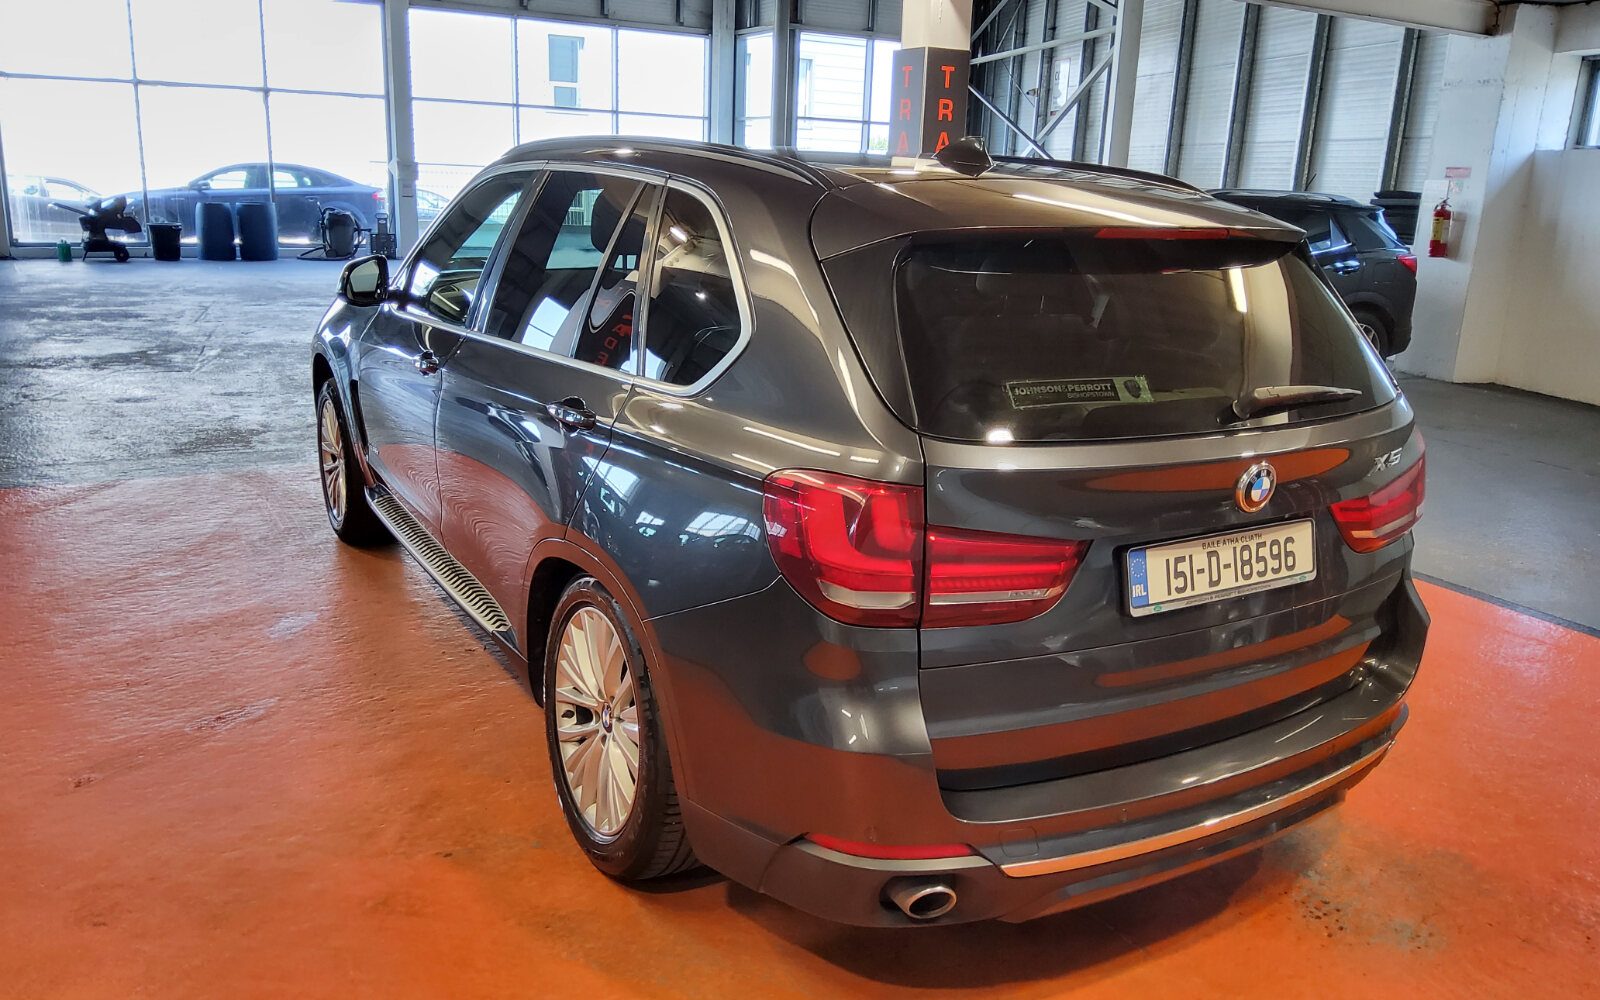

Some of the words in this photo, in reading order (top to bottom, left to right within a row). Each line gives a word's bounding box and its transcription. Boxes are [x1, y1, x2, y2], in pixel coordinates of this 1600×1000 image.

[1067, 391, 1115, 399] BISHOPSTOWN
[1373, 447, 1403, 472] X5
[1201, 540, 1221, 550] BAILE
[1240, 533, 1263, 544] CLIATH
[1165, 536, 1296, 596] 151-D-18596
[1132, 584, 1147, 598] IRL
